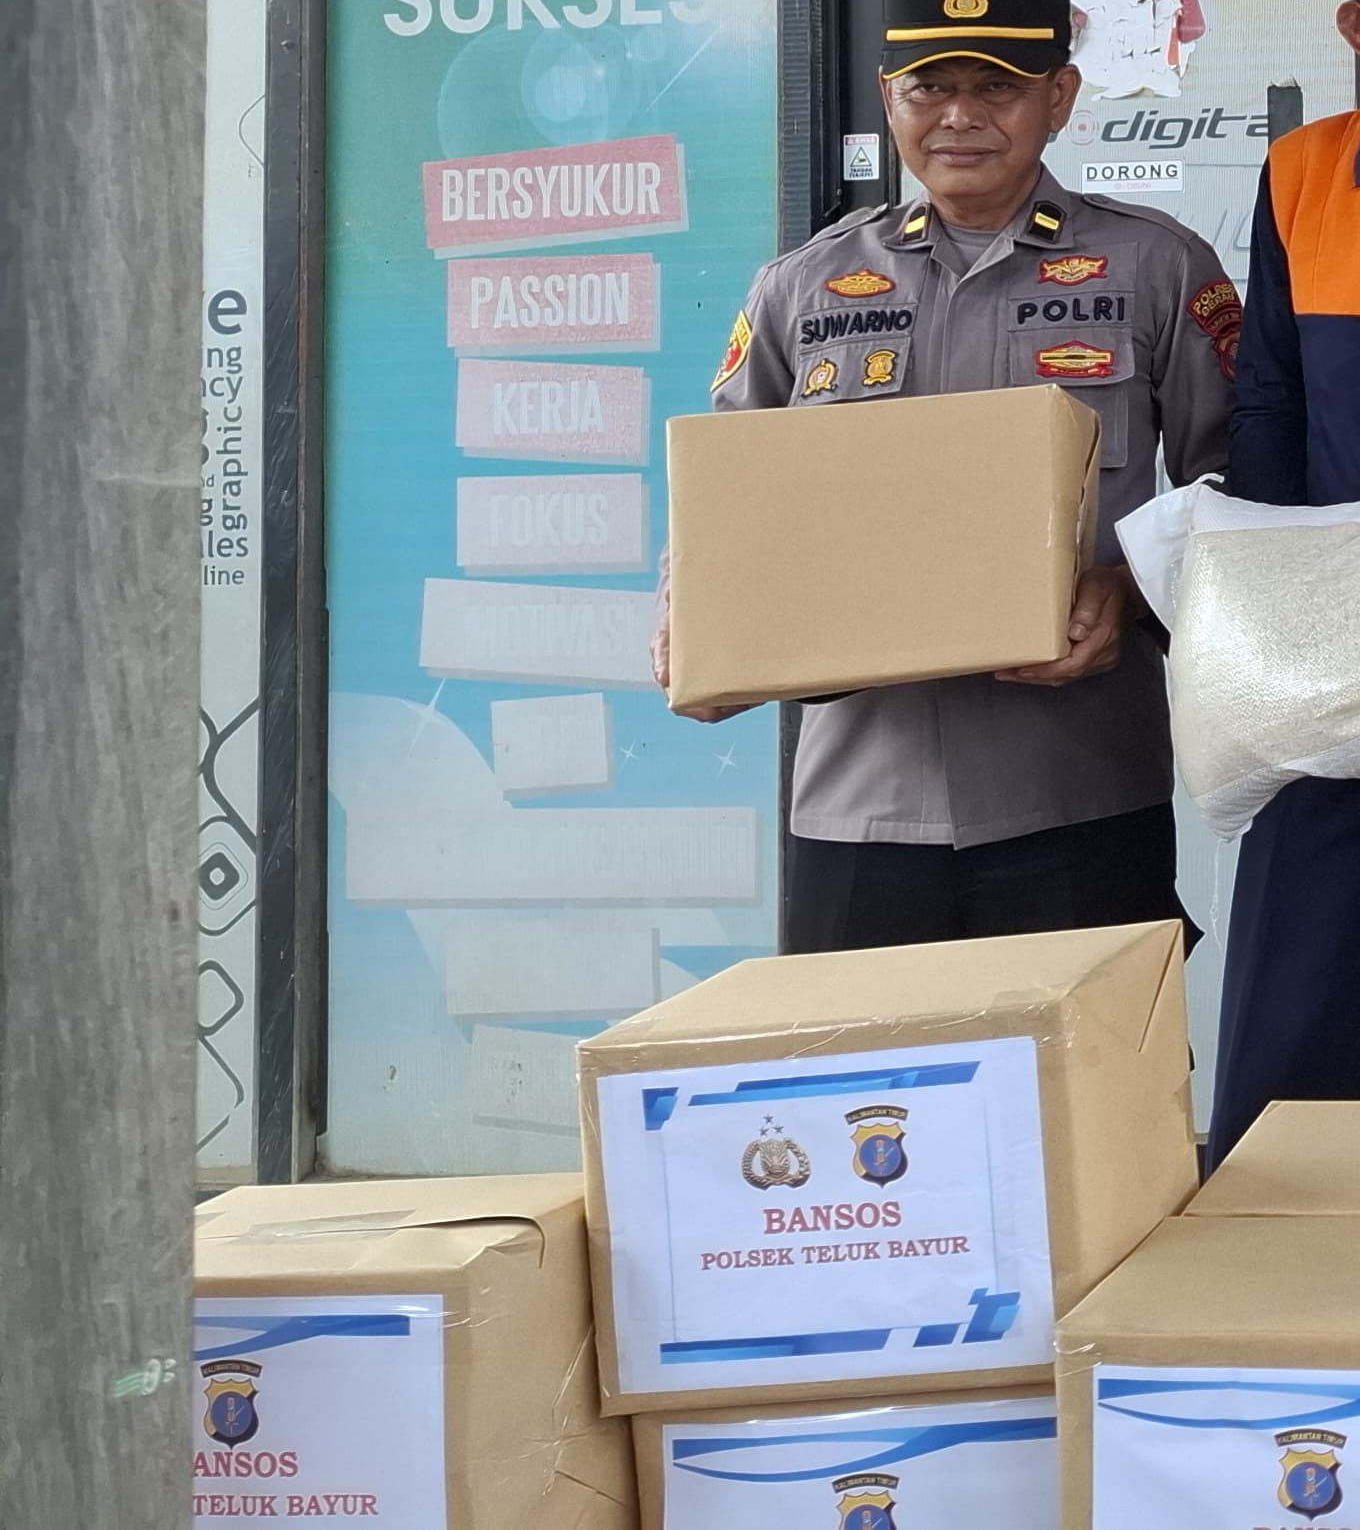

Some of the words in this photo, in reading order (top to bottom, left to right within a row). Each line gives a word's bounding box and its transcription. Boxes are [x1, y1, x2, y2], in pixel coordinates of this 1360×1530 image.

[1101, 107, 1269, 150] digita
[441, 161, 662, 223] BERSYUKUR
[1086, 164, 1179, 180] DORONG
[469, 271, 630, 329] PASSION
[800, 307, 914, 345] SUWARNO
[1016, 295, 1126, 325] POLRI
[492, 379, 606, 436] KERJA
[215, 405, 249, 532] graphic
[488, 492, 610, 549] FOKUS
[762, 1201, 902, 1234] BANSOS
[701, 1247, 794, 1271] POLSEK
[800, 1241, 881, 1264] TELUK
[887, 1235, 970, 1260] BAYUR
[191, 1451, 299, 1478] ANSOS
[286, 1494, 379, 1517] BAYUR
